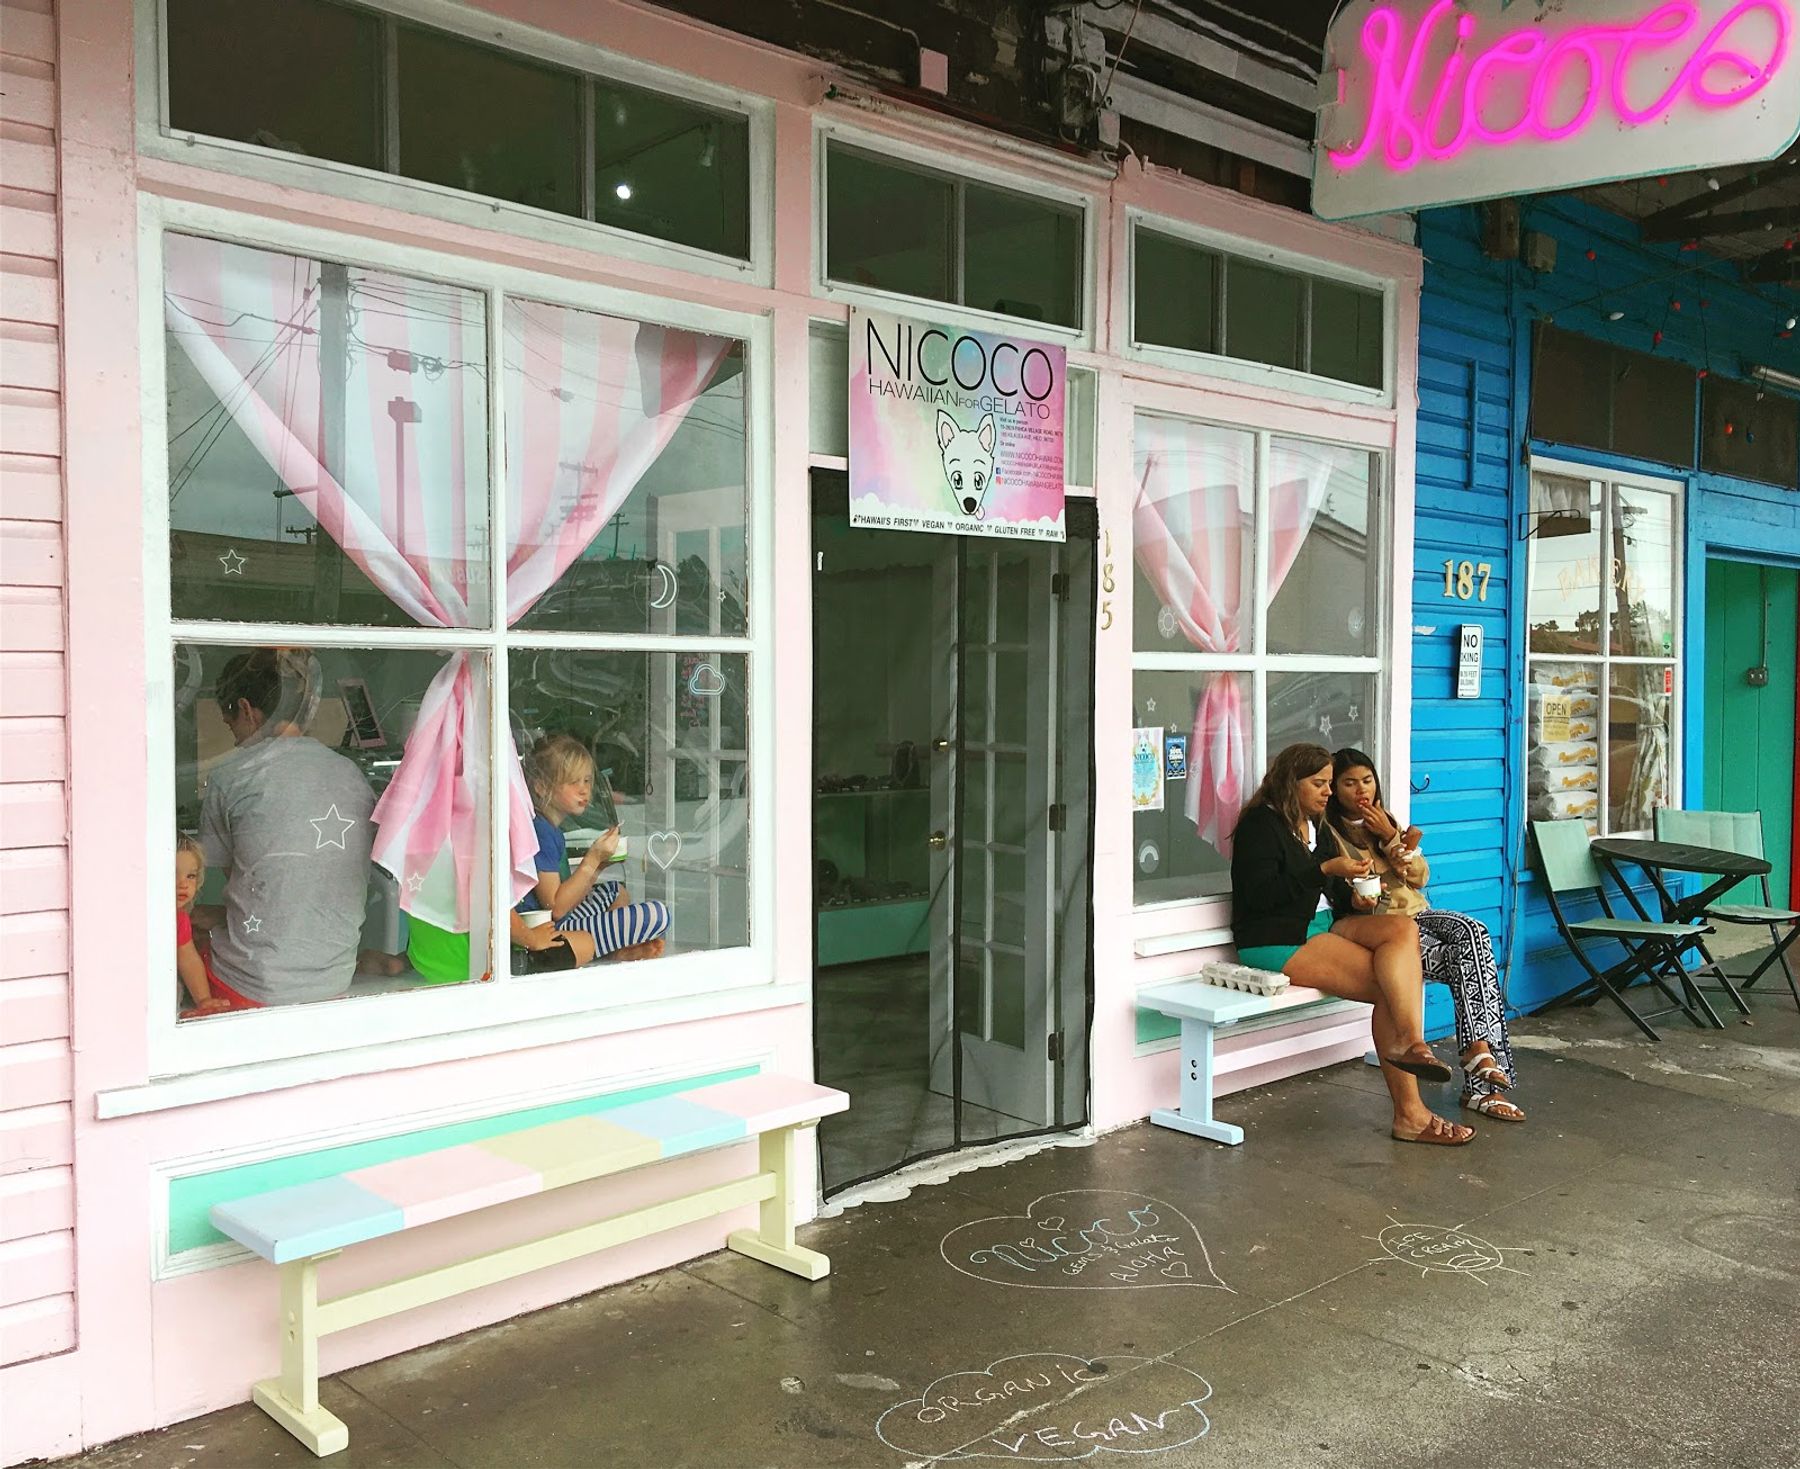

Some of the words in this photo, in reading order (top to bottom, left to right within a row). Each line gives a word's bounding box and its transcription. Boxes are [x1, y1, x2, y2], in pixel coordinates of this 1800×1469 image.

[1329, 0, 1792, 170] Nicoco
[867, 318, 1054, 402] NICOCO
[894, 517, 912, 527] FIRST
[922, 520, 945, 529] VEGAN
[956, 523, 985, 533] ORGANIC
[995, 526, 1019, 535] GLUTEN
[1020, 528, 1036, 537] FREE
[1442, 559, 1492, 602] 187
[1463, 634, 1479, 648] NO
[1546, 702, 1567, 716] OPEN
[992, 1408, 1181, 1453] VEGAN
